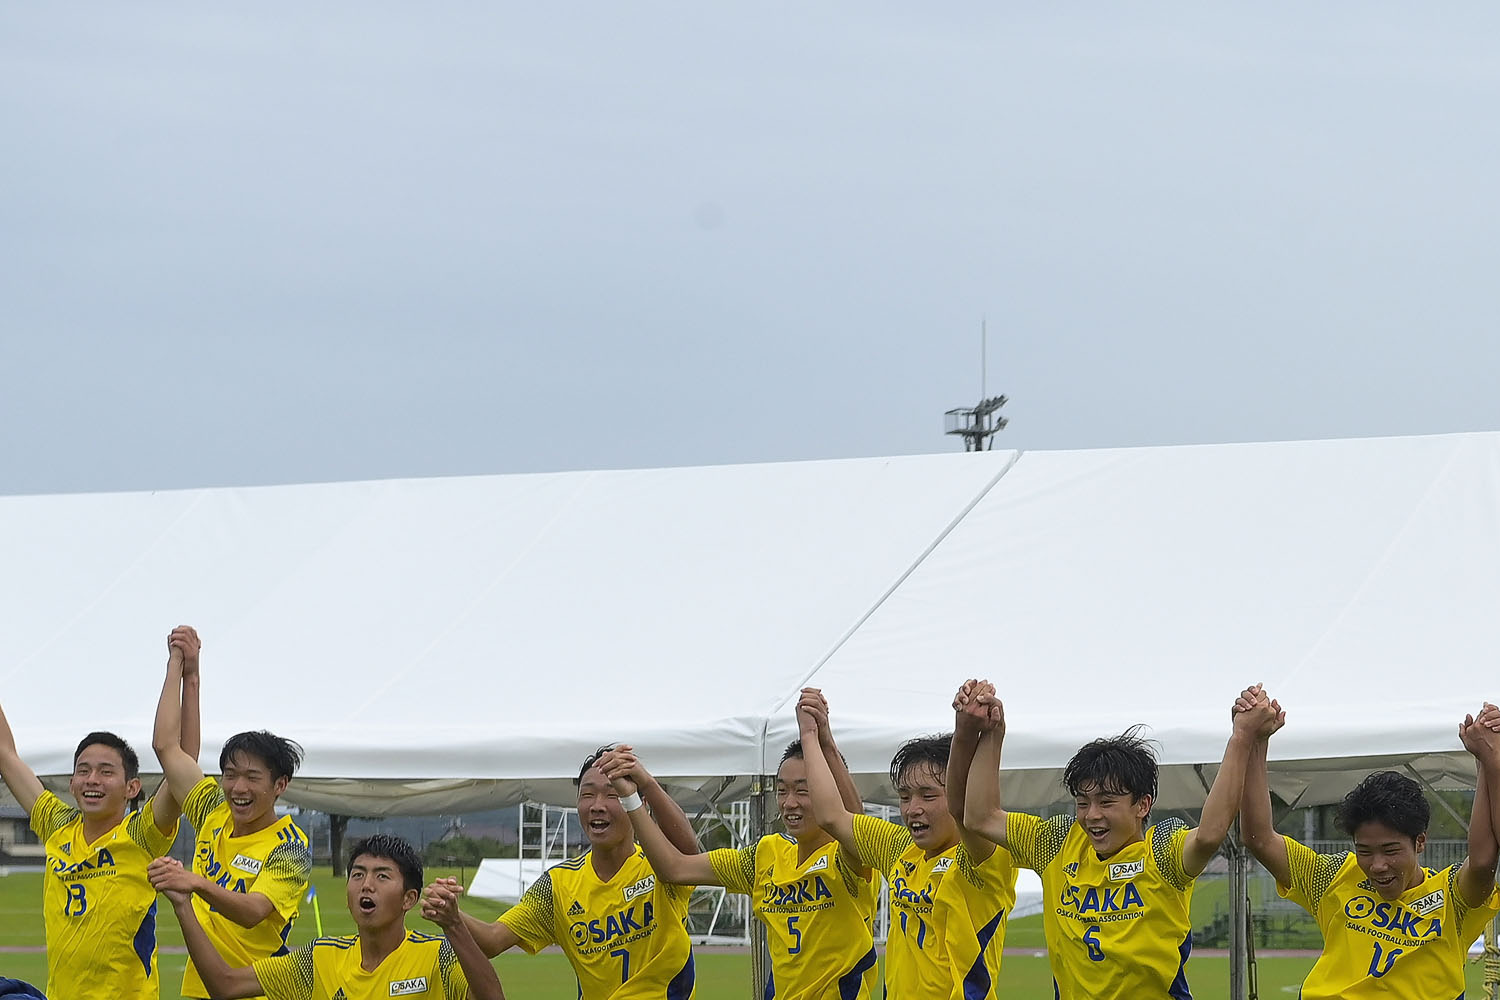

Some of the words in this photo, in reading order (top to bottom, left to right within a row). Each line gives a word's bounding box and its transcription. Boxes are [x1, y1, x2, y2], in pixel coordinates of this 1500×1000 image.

[64, 883, 88, 917] 13
[626, 878, 655, 898] OSAKA
[763, 876, 833, 906] OSAKA
[569, 900, 655, 947] OSAKA
[899, 911, 927, 950] 11
[1099, 911, 1145, 923] ASSOCIATION
[1345, 896, 1442, 938] OSAKA
[787, 916, 802, 955] 5
[1083, 925, 1105, 962] 6
[1367, 927, 1401, 945] FOOTBALL
[609, 948, 631, 984] 7
[391, 979, 426, 994] OSAKA
